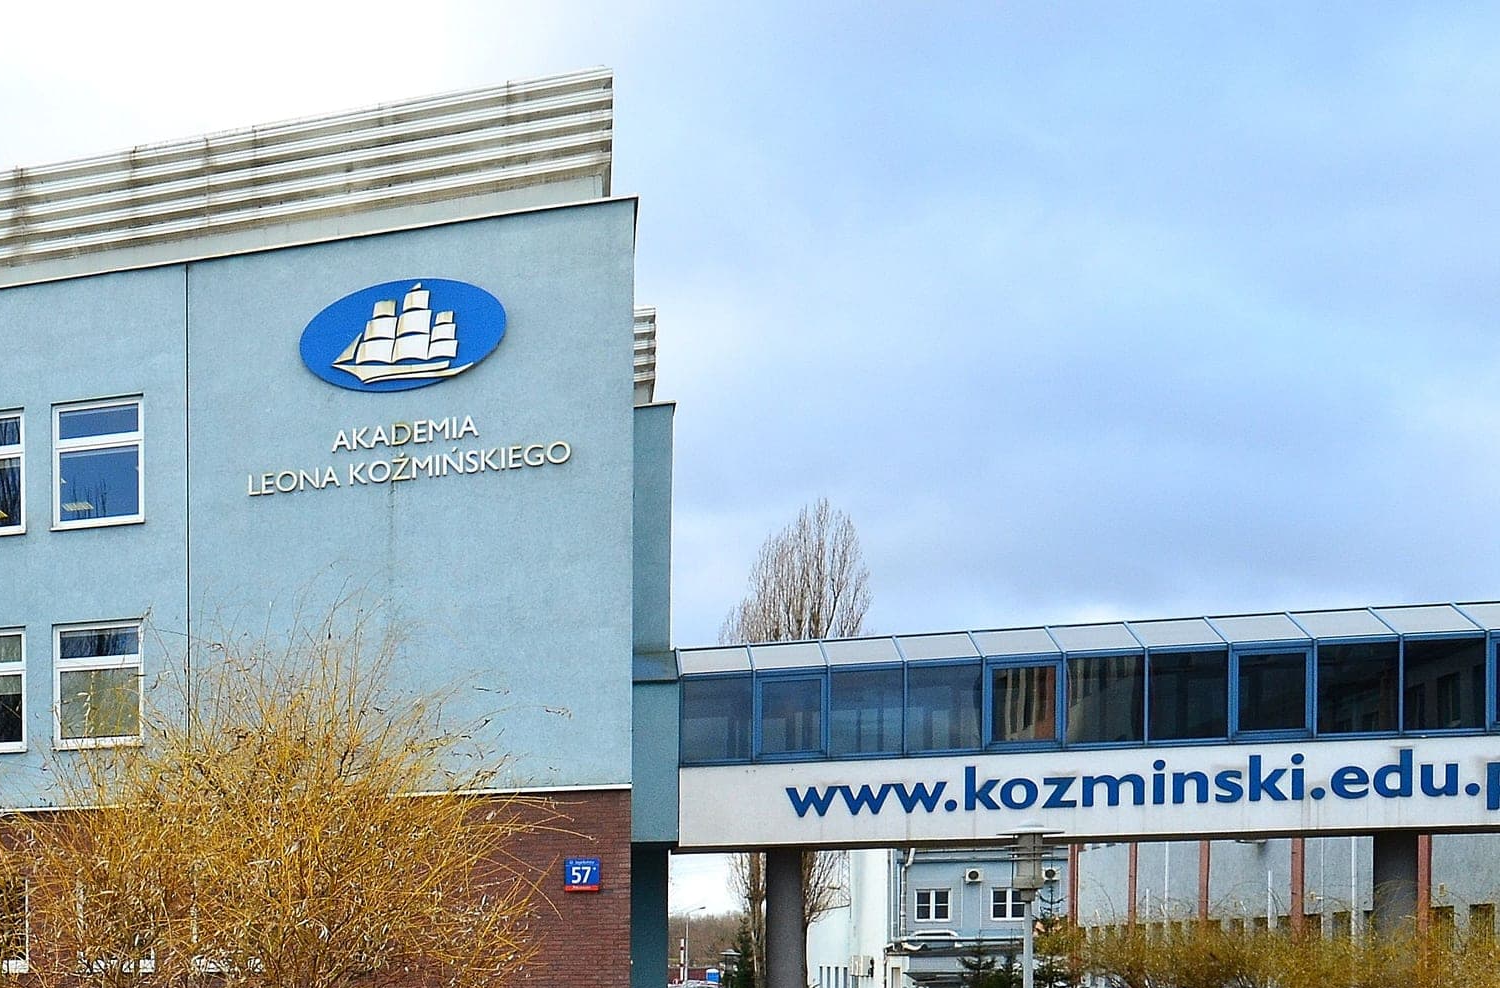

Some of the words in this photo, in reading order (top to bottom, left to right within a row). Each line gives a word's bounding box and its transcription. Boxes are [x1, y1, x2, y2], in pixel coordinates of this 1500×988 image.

[331, 415, 479, 453] AKADEMIA
[247, 466, 341, 497] LEONA
[348, 440, 572, 486] KOŹMIŃSKIEGO
